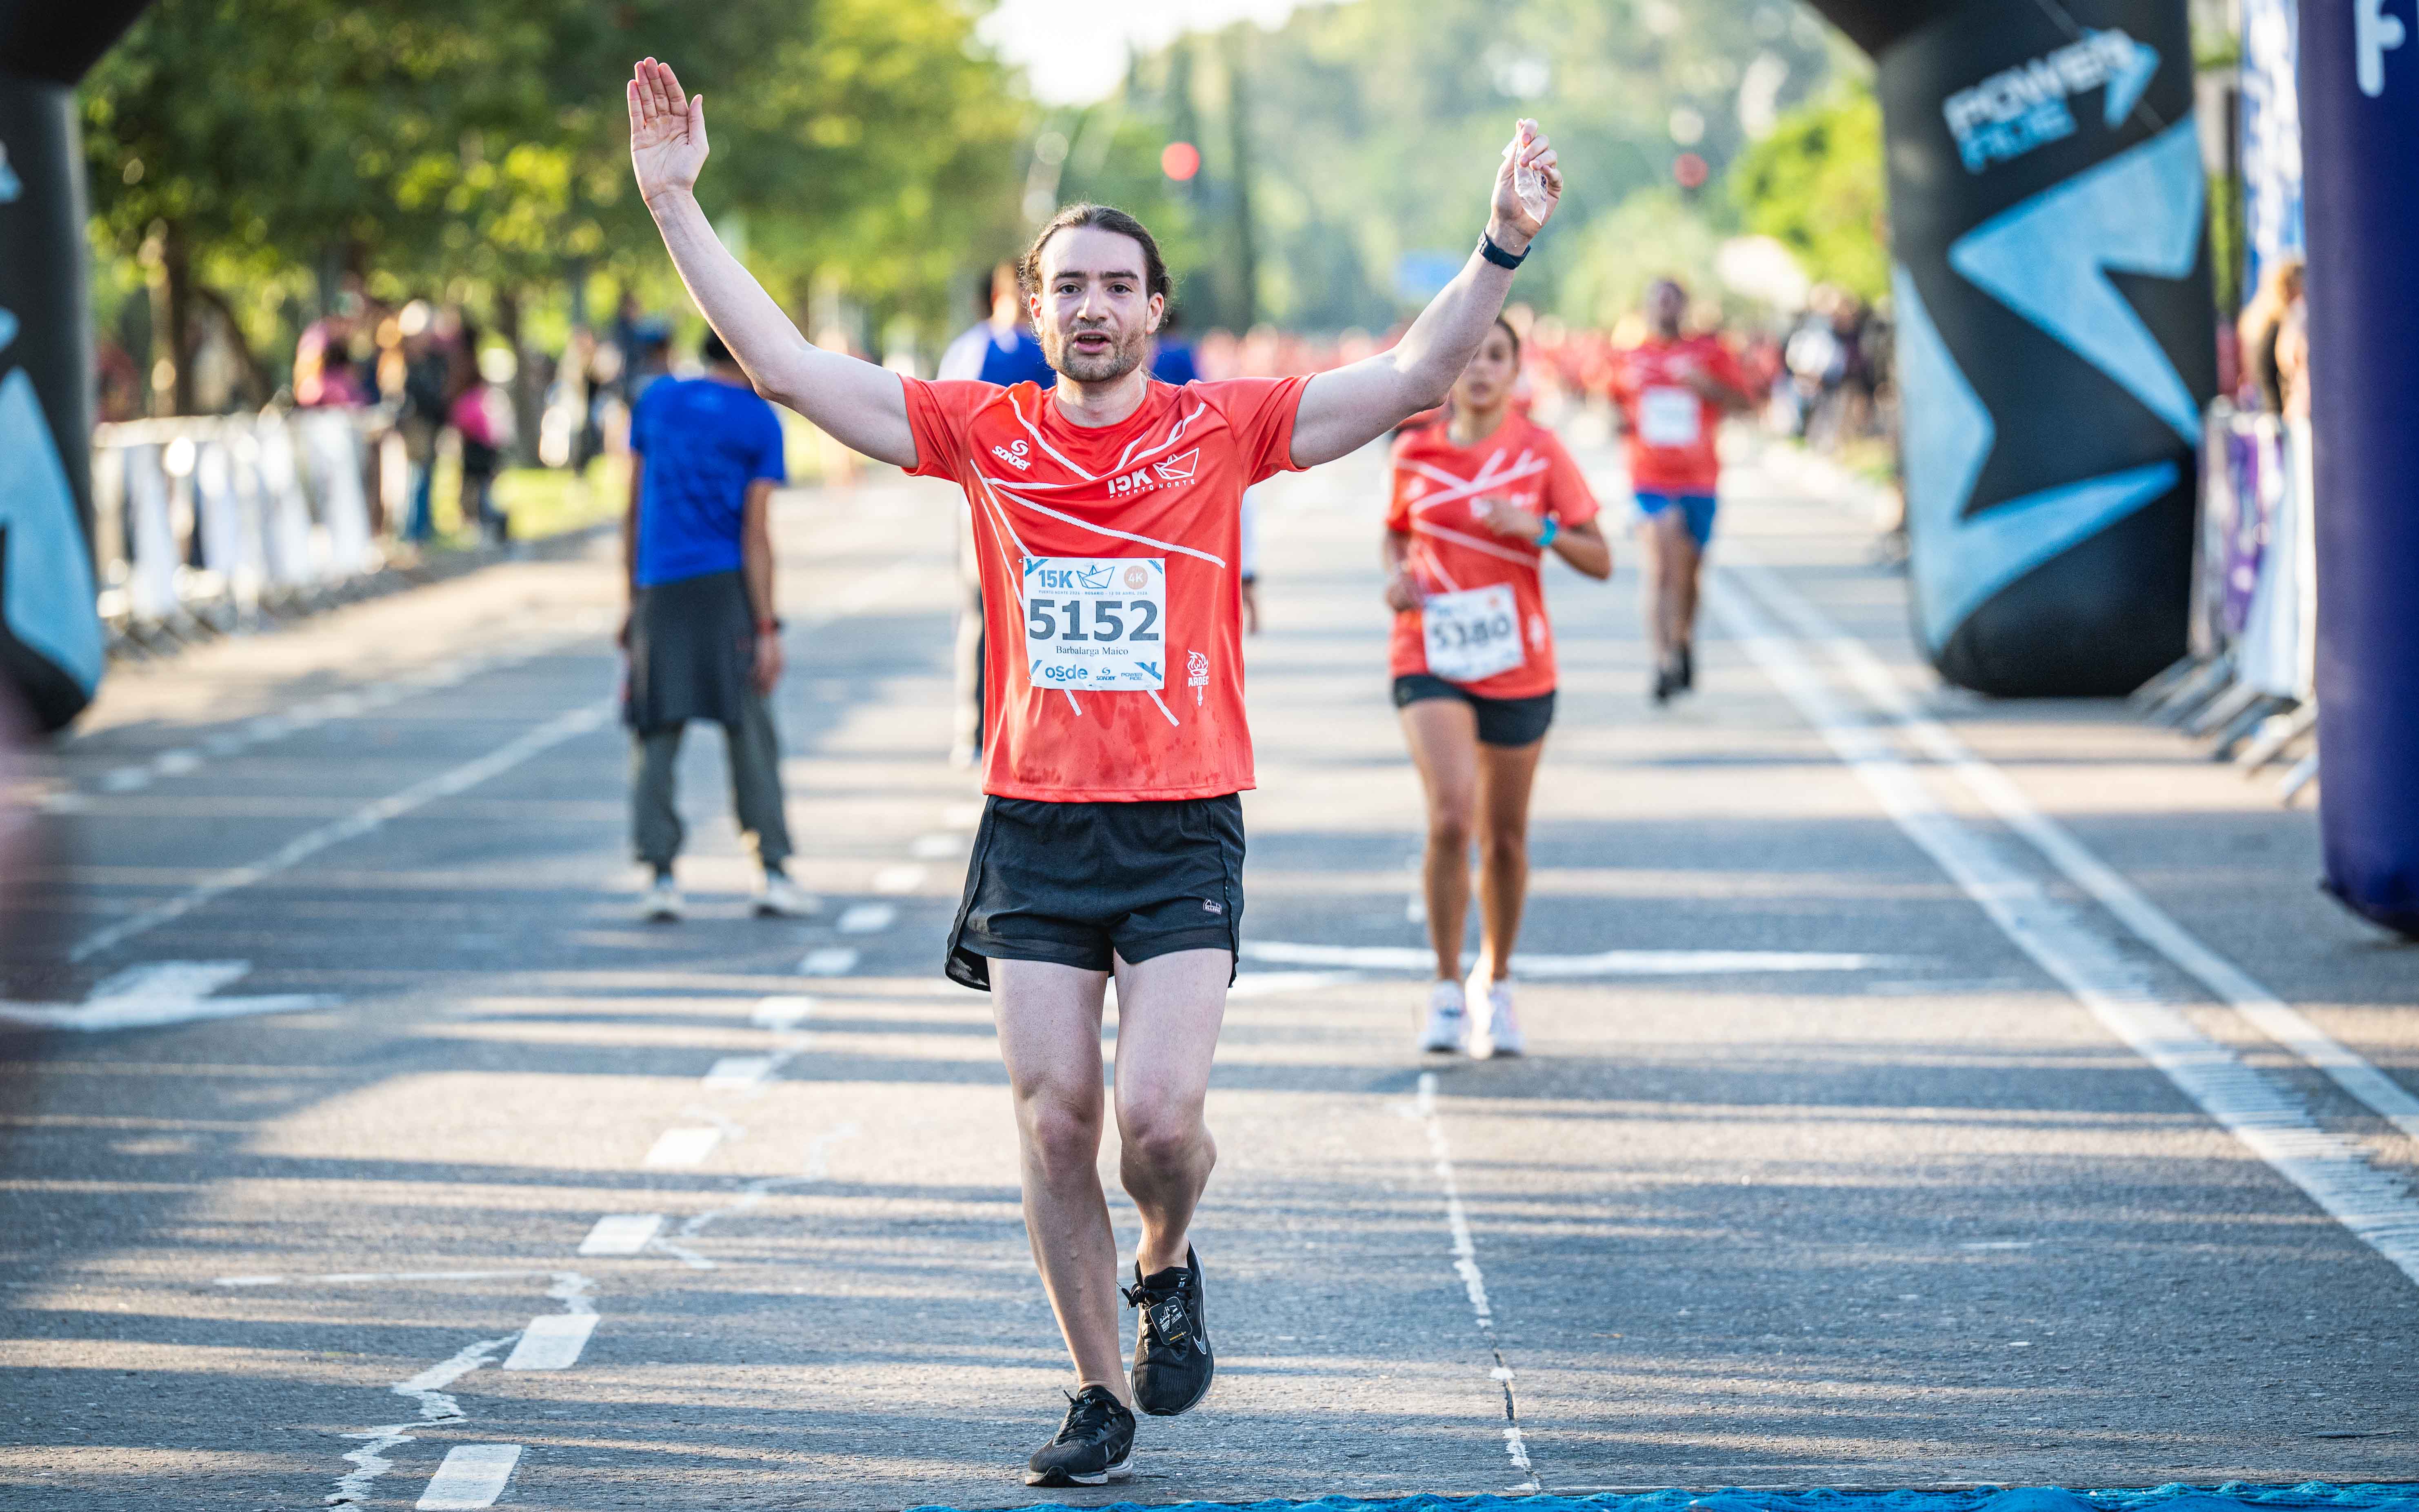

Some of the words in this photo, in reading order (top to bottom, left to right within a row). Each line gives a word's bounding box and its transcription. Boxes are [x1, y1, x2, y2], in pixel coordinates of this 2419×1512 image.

[1943, 29, 2135, 140] POWER
[1108, 467, 1153, 494] 15K
[1159, 479, 1195, 489] NORTE
[1039, 570, 1073, 588] 15K
[1128, 573, 1143, 583] 4K
[1029, 599, 1159, 642] 5152
[1056, 646, 1099, 657] Barbalarga
[1102, 647, 1128, 655] Maico
[1045, 664, 1088, 681] osde
[1188, 676, 1208, 687] ARDEC
